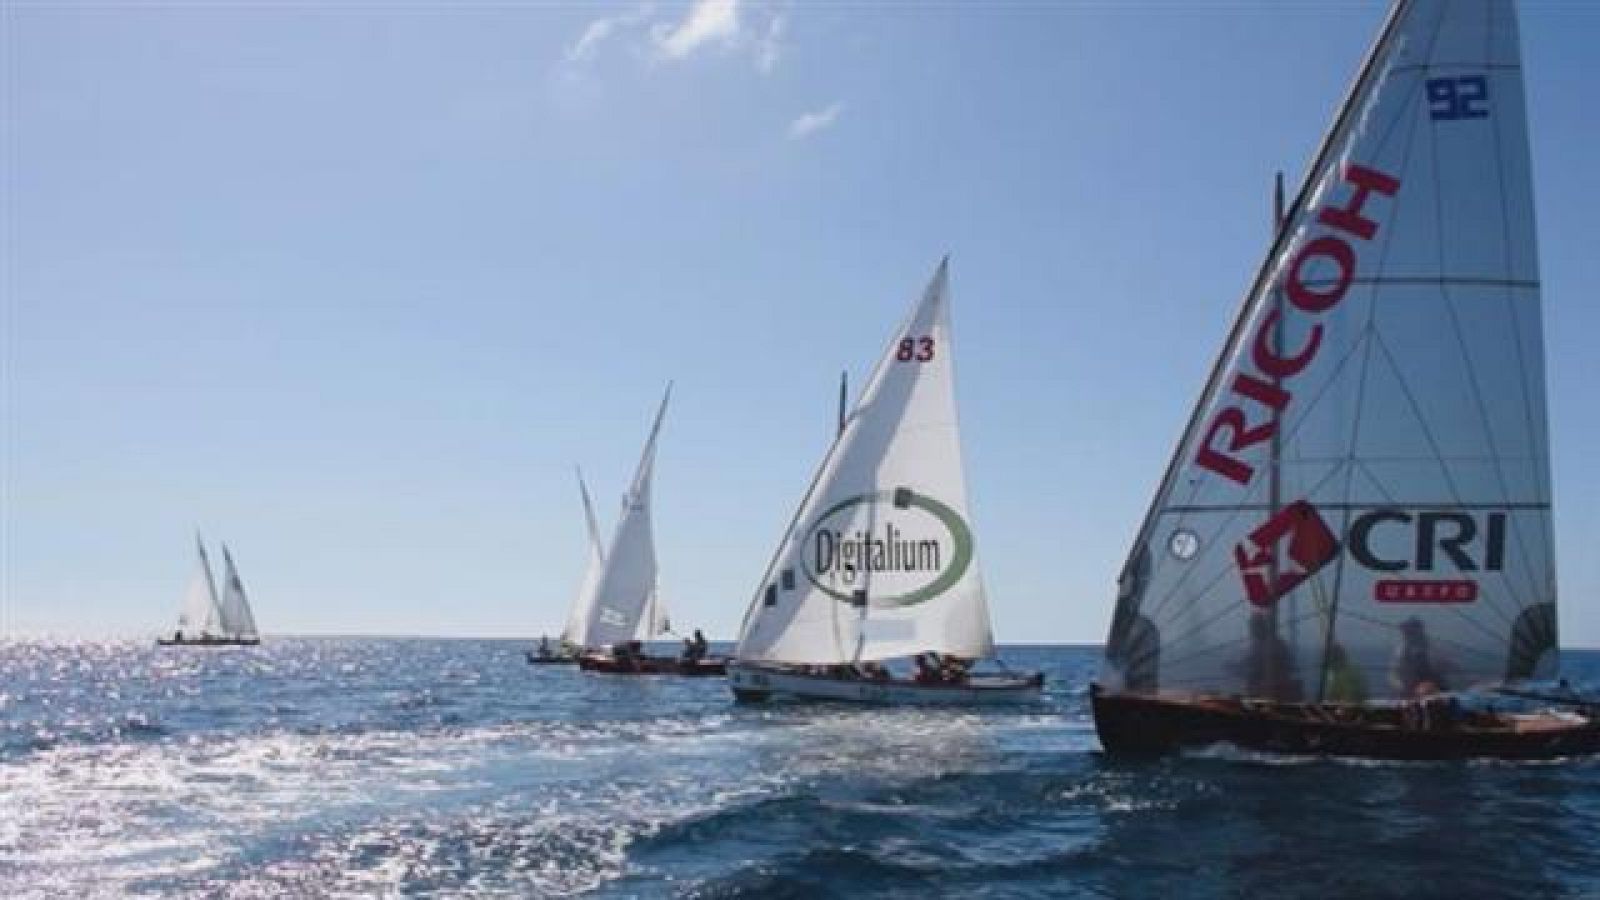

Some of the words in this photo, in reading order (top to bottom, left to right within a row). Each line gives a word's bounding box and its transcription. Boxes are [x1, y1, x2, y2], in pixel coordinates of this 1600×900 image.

[1425, 75, 1488, 120] 92
[896, 336, 935, 362] 83
[1195, 163, 1401, 485] RICOH
[815, 523, 941, 584] Digitalium
[1349, 510, 1506, 571] CRI
